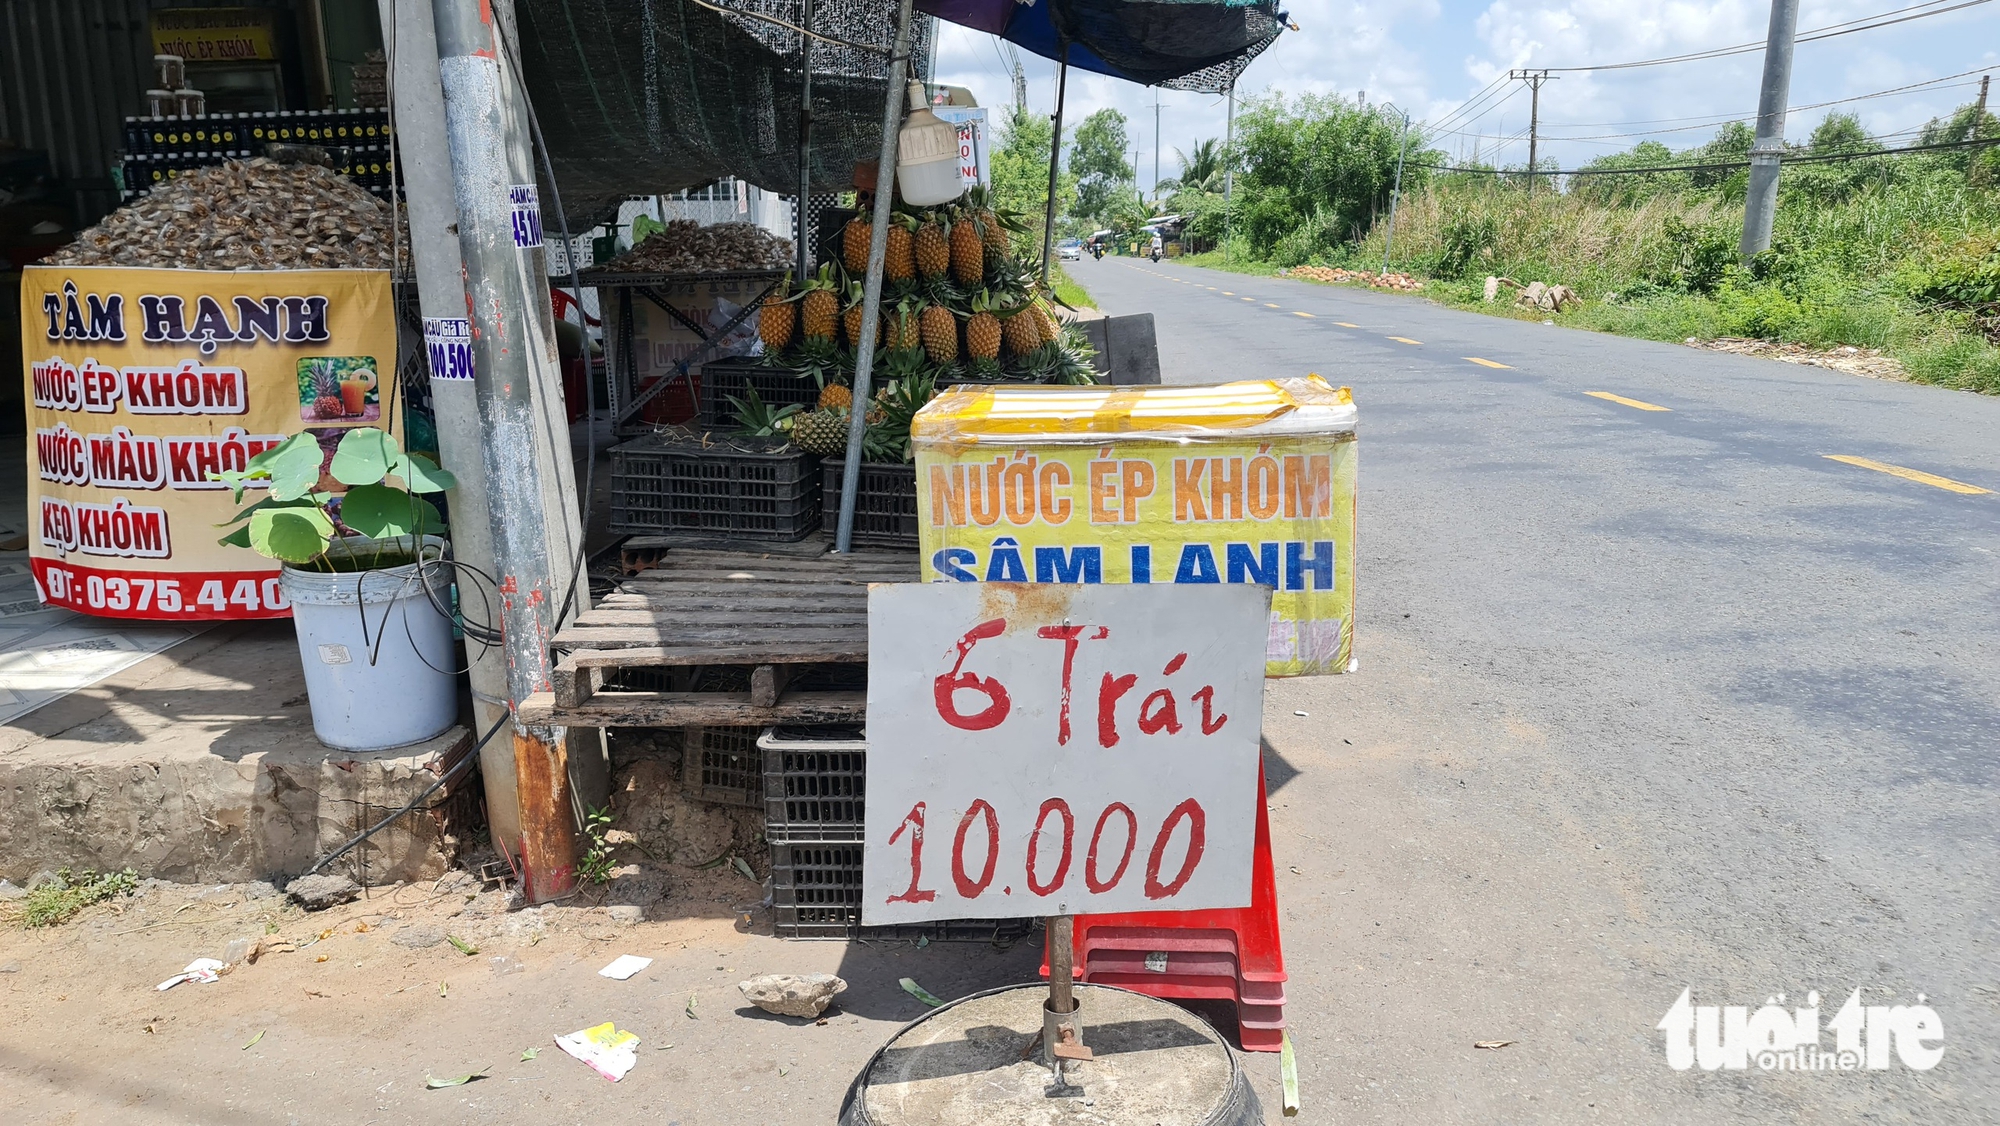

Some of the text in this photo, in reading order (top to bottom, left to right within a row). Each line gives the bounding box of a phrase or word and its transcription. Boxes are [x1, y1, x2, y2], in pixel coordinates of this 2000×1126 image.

[216, 34, 256, 57] KHÓM
[43, 279, 331, 354] TÂM HẠNH
[33, 362, 238, 408] NƯỚC ÉP KHÓM
[37, 428, 84, 479] NƯỚC
[90, 432, 156, 483] MÀU
[928, 443, 1332, 526] NƯỚC ÉP KHÓM
[42, 501, 162, 551] KẸO KHÓM
[47, 567, 82, 604] ĐT:
[932, 537, 1101, 583] SÂM
[934, 618, 1011, 731] 6
[886, 797, 1206, 903] 10.000
